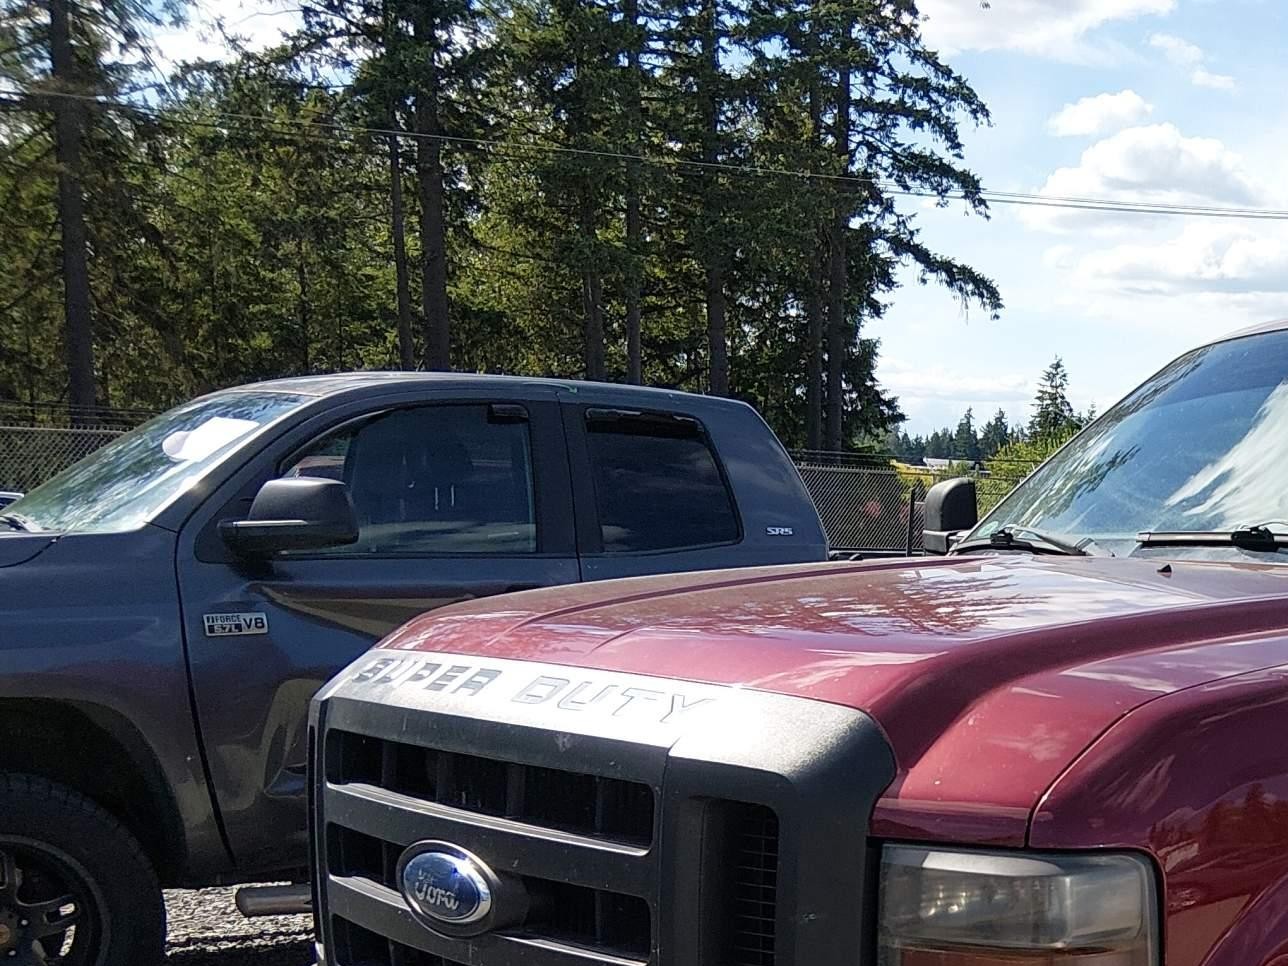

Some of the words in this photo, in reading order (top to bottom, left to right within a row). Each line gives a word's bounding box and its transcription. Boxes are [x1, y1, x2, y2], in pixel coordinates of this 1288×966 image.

[243, 616, 265, 630] V8
[352, 656, 502, 697] SUPER
[511, 675, 716, 723] DUTY
[414, 867, 460, 911] Ford
